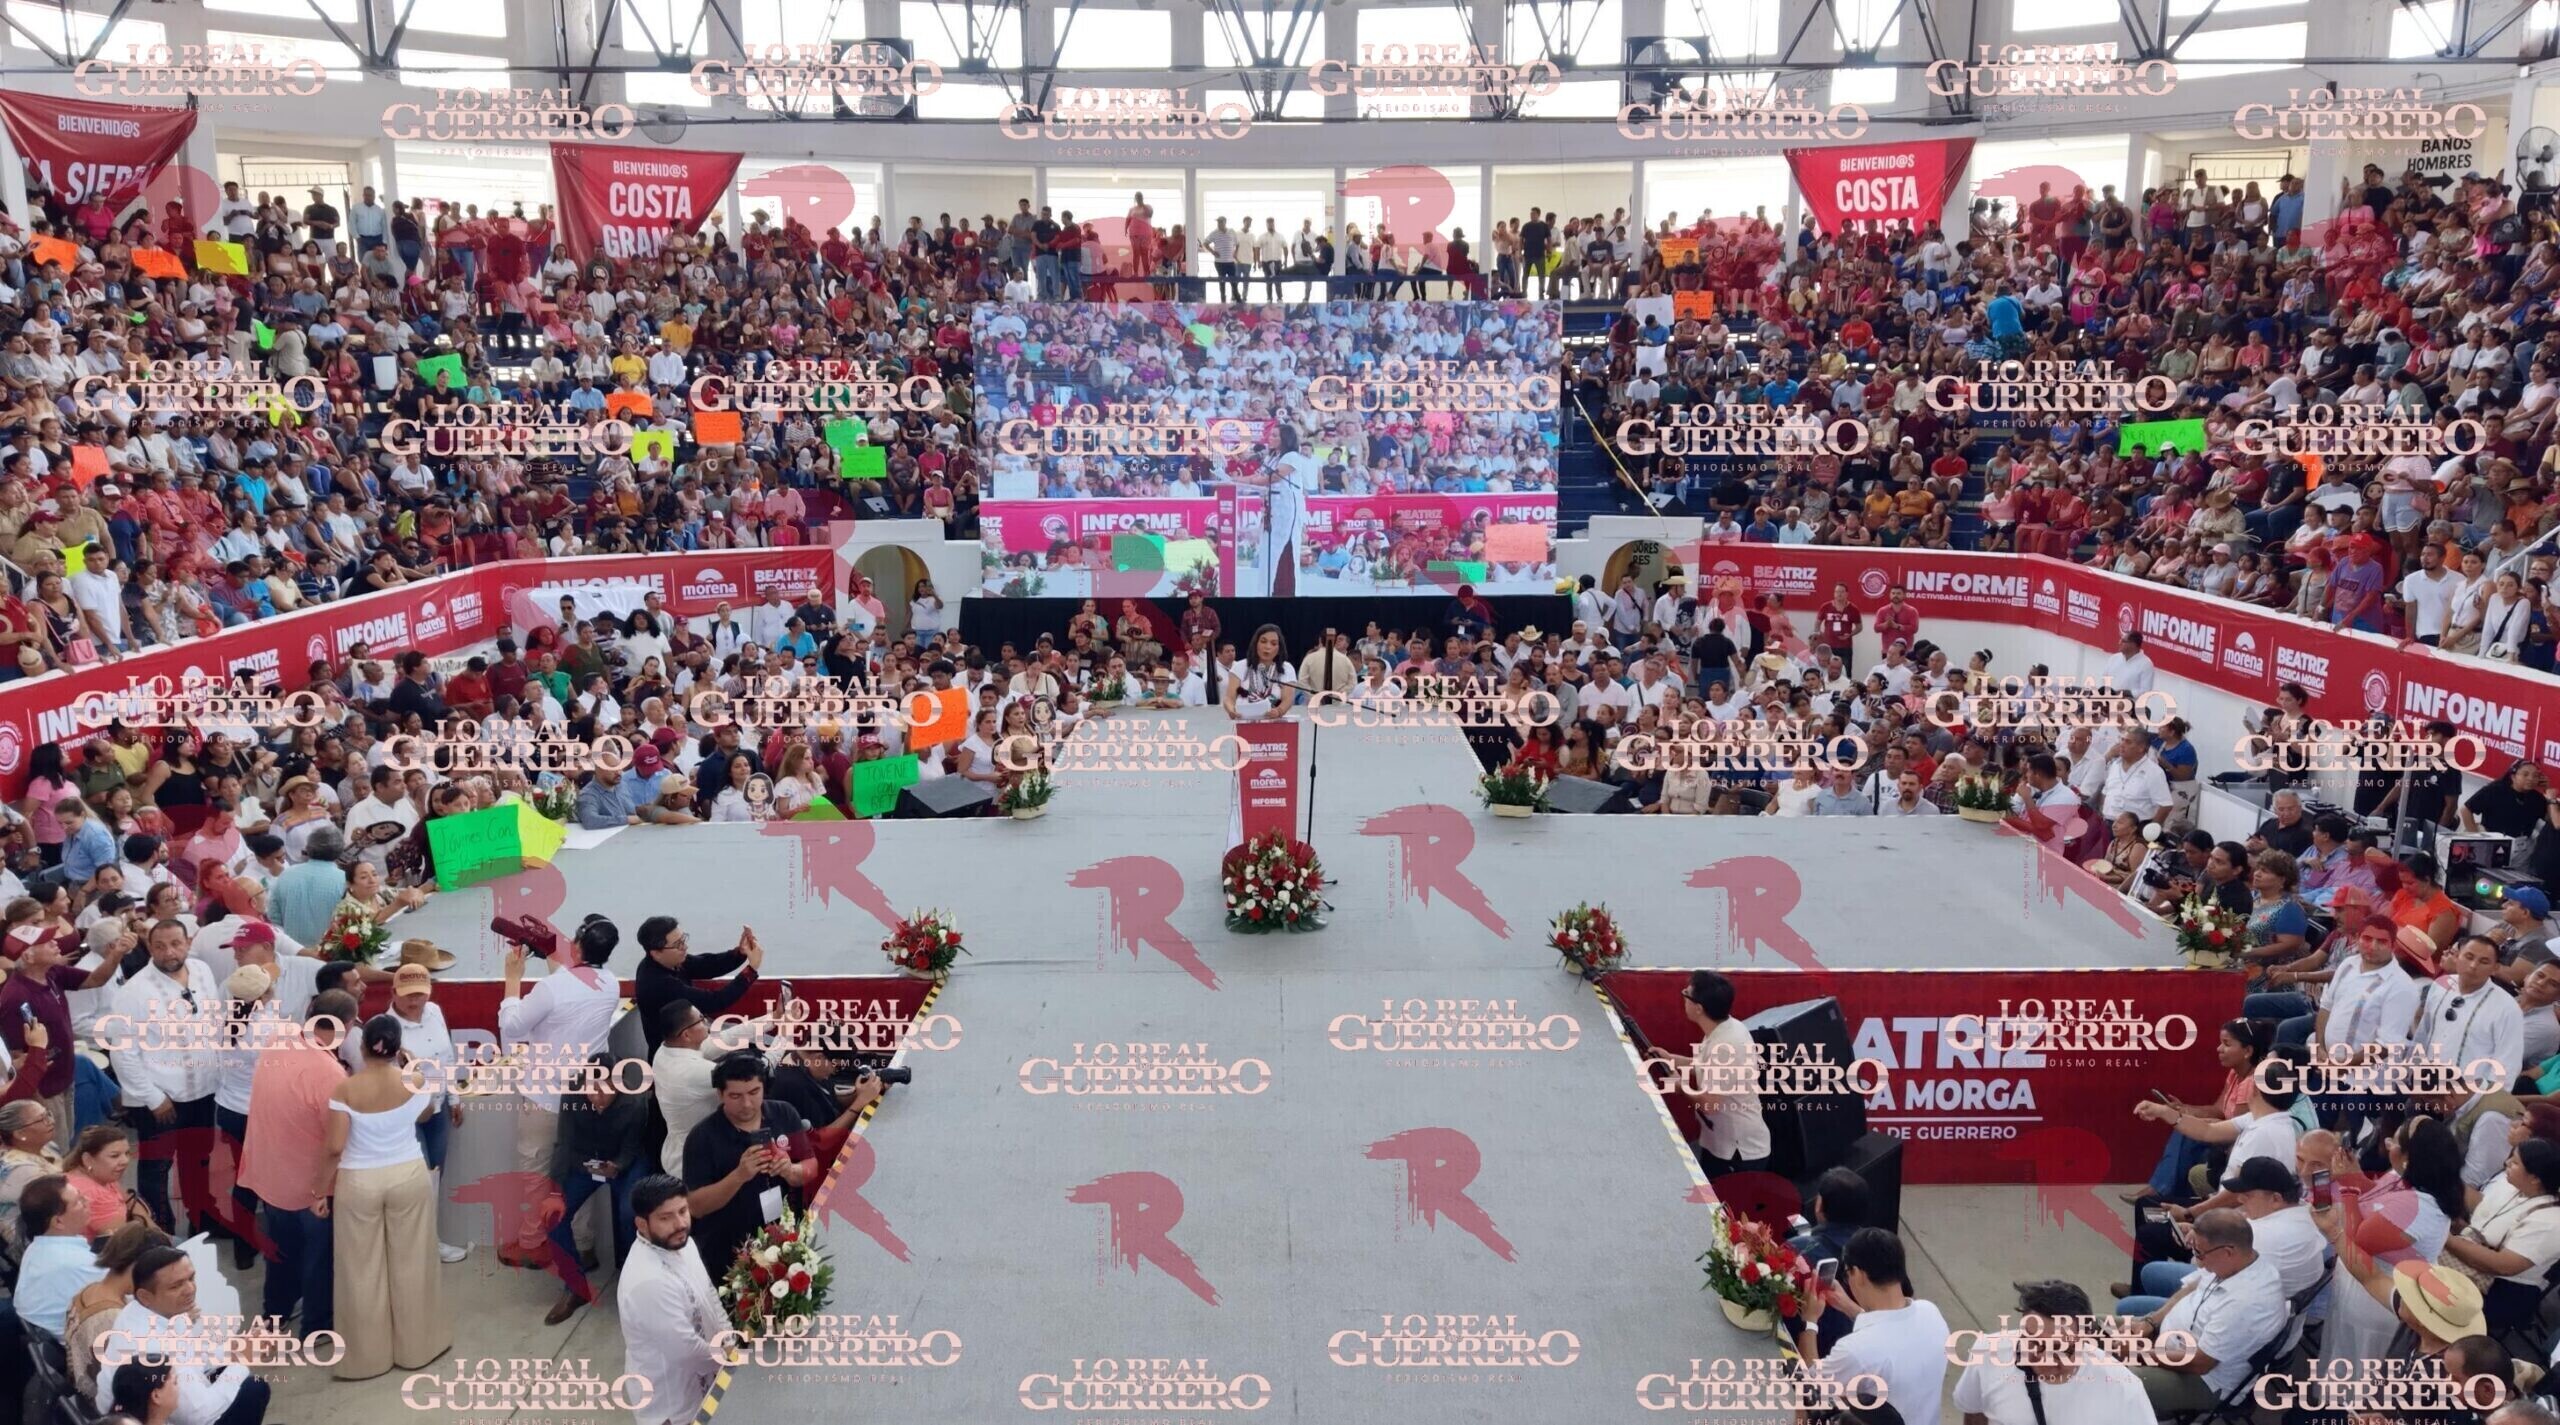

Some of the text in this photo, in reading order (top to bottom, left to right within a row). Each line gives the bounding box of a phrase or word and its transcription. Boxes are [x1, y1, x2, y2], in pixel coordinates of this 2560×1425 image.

[57, 113, 141, 138] BIENVENID@S
[613, 160, 688, 179] BIENVENID@S
[1840, 154, 1915, 172] BIENVENID@S
[2407, 154, 2472, 172] HOMBRES
[609, 181, 693, 219] COSTA
[1836, 176, 1920, 212] COSTA
[602, 224, 673, 259] GRAN
[754, 567, 818, 583] BEATRIZ
[1754, 565, 1818, 580] BEATRIZ
[682, 582, 738, 596] morena
[1785, 581, 1815, 590] MORGA
[1906, 570, 2029, 598] INFORME
[1916, 593, 1962, 601] ACTIVIDADES
[336, 612, 409, 654] INFORME
[415, 616, 447, 635] morena
[2142, 608, 2217, 652] INFORME
[2224, 648, 2264, 672] morena
[2277, 646, 2329, 677] BEATRIZ
[2300, 674, 2326, 690] MORGA
[2405, 680, 2529, 744] INFORME
[1250, 778, 1287, 787] morena
[1852, 1016, 2049, 1070] ATRIZ
[1904, 1078, 2037, 1111] MORGA
[1916, 1125, 2018, 1140] GUERRERO
